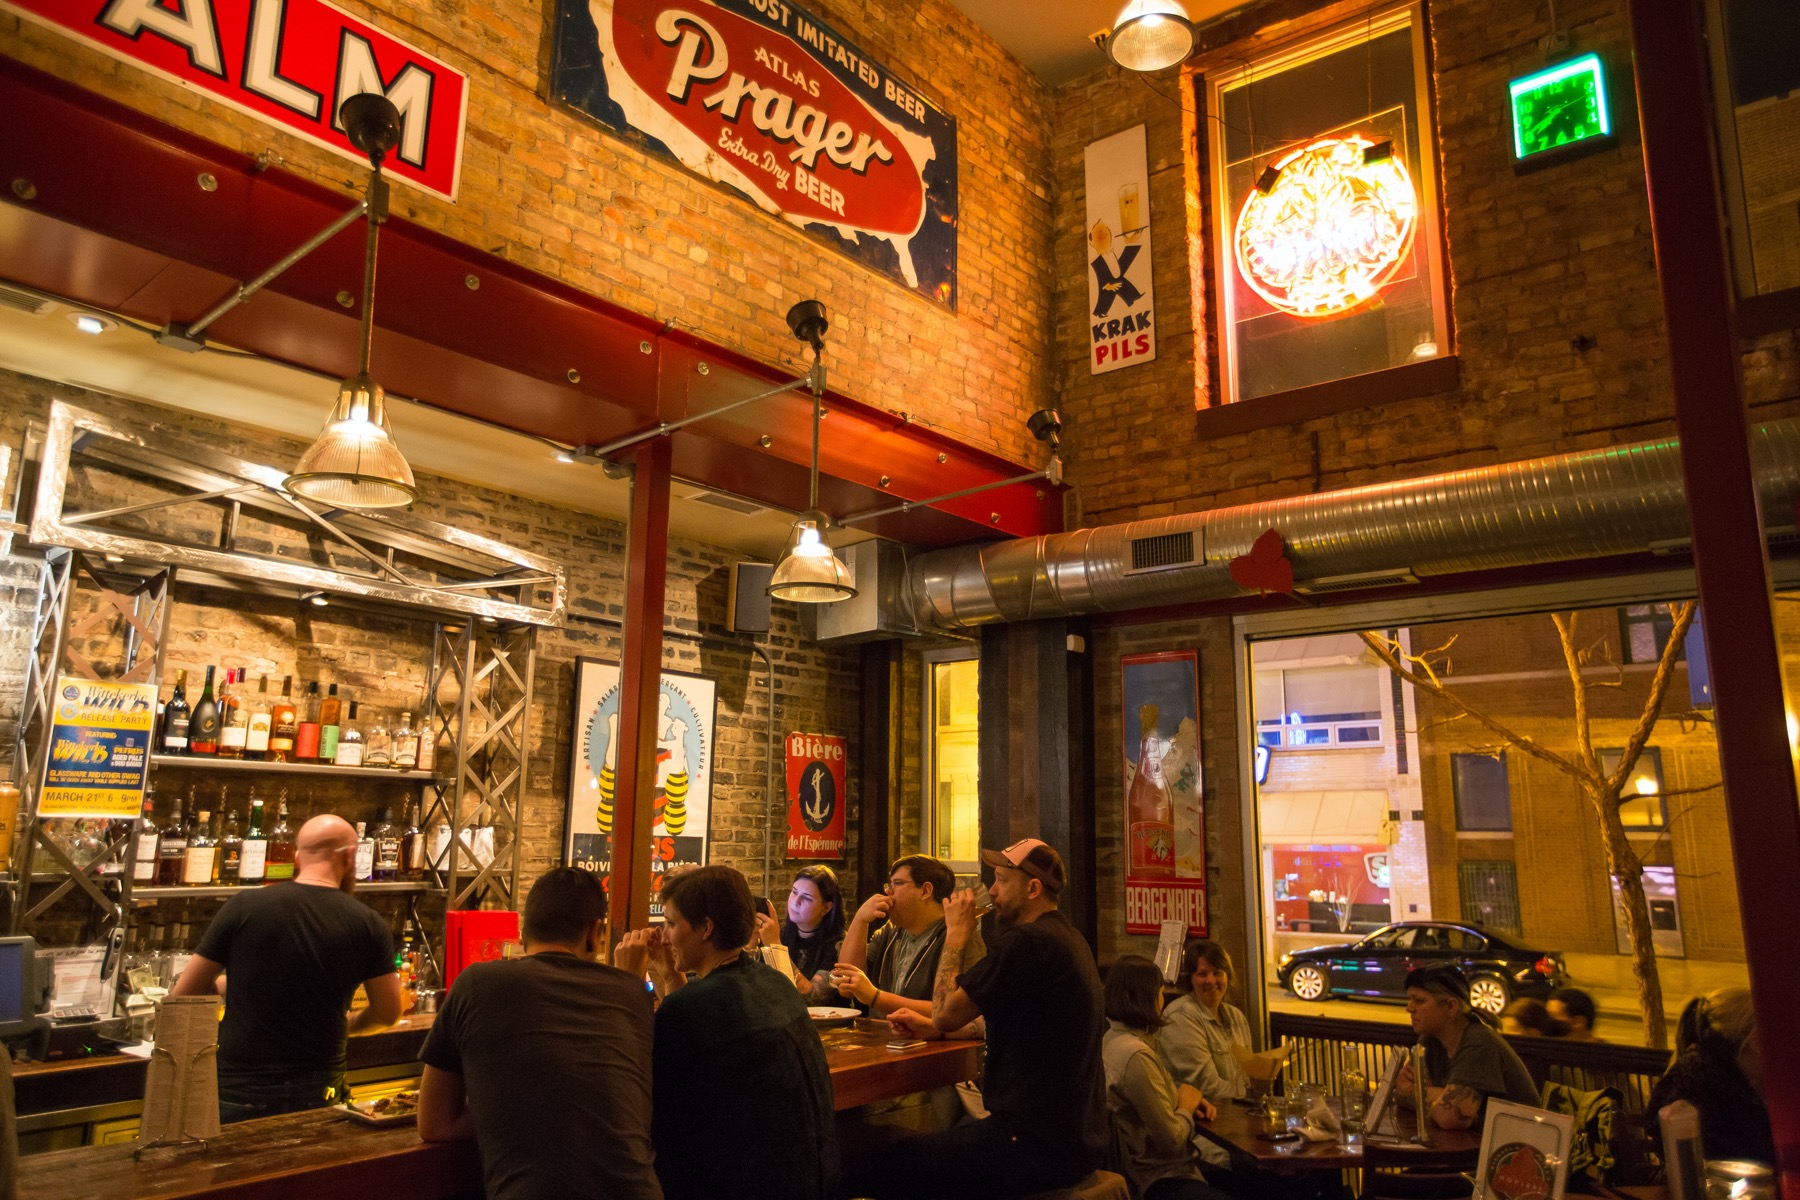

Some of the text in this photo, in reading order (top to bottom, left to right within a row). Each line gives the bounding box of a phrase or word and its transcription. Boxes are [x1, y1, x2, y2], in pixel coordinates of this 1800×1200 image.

[749, 0, 925, 124] OST IMITATED BEER
[754, 46, 820, 98] ATLAS
[96, 0, 435, 171] ALM
[655, 9, 893, 172] Prager
[718, 127, 845, 217] Extra Dry BEER
[1092, 310, 1152, 344] KRAK
[1095, 334, 1150, 366] PILS
[597, 682, 620, 707] SALAR
[660, 678, 687, 699] ERÇANT
[81, 713, 148, 725] RELEASE PARTY
[583, 717, 596, 760] ARTISAN
[690, 706, 706, 770] CULTIVATEUR
[791, 736, 843, 761] Bière
[53, 747, 109, 764] WILD
[49, 769, 88, 778] GLASSWARE
[101, 772, 121, 780] OTHER
[46, 791, 83, 802] MARCH
[108, 793, 114, 802] 6
[121, 794, 138, 803] 9PM
[788, 834, 799, 850] de
[1126, 886, 1206, 927] BERGENBIER
